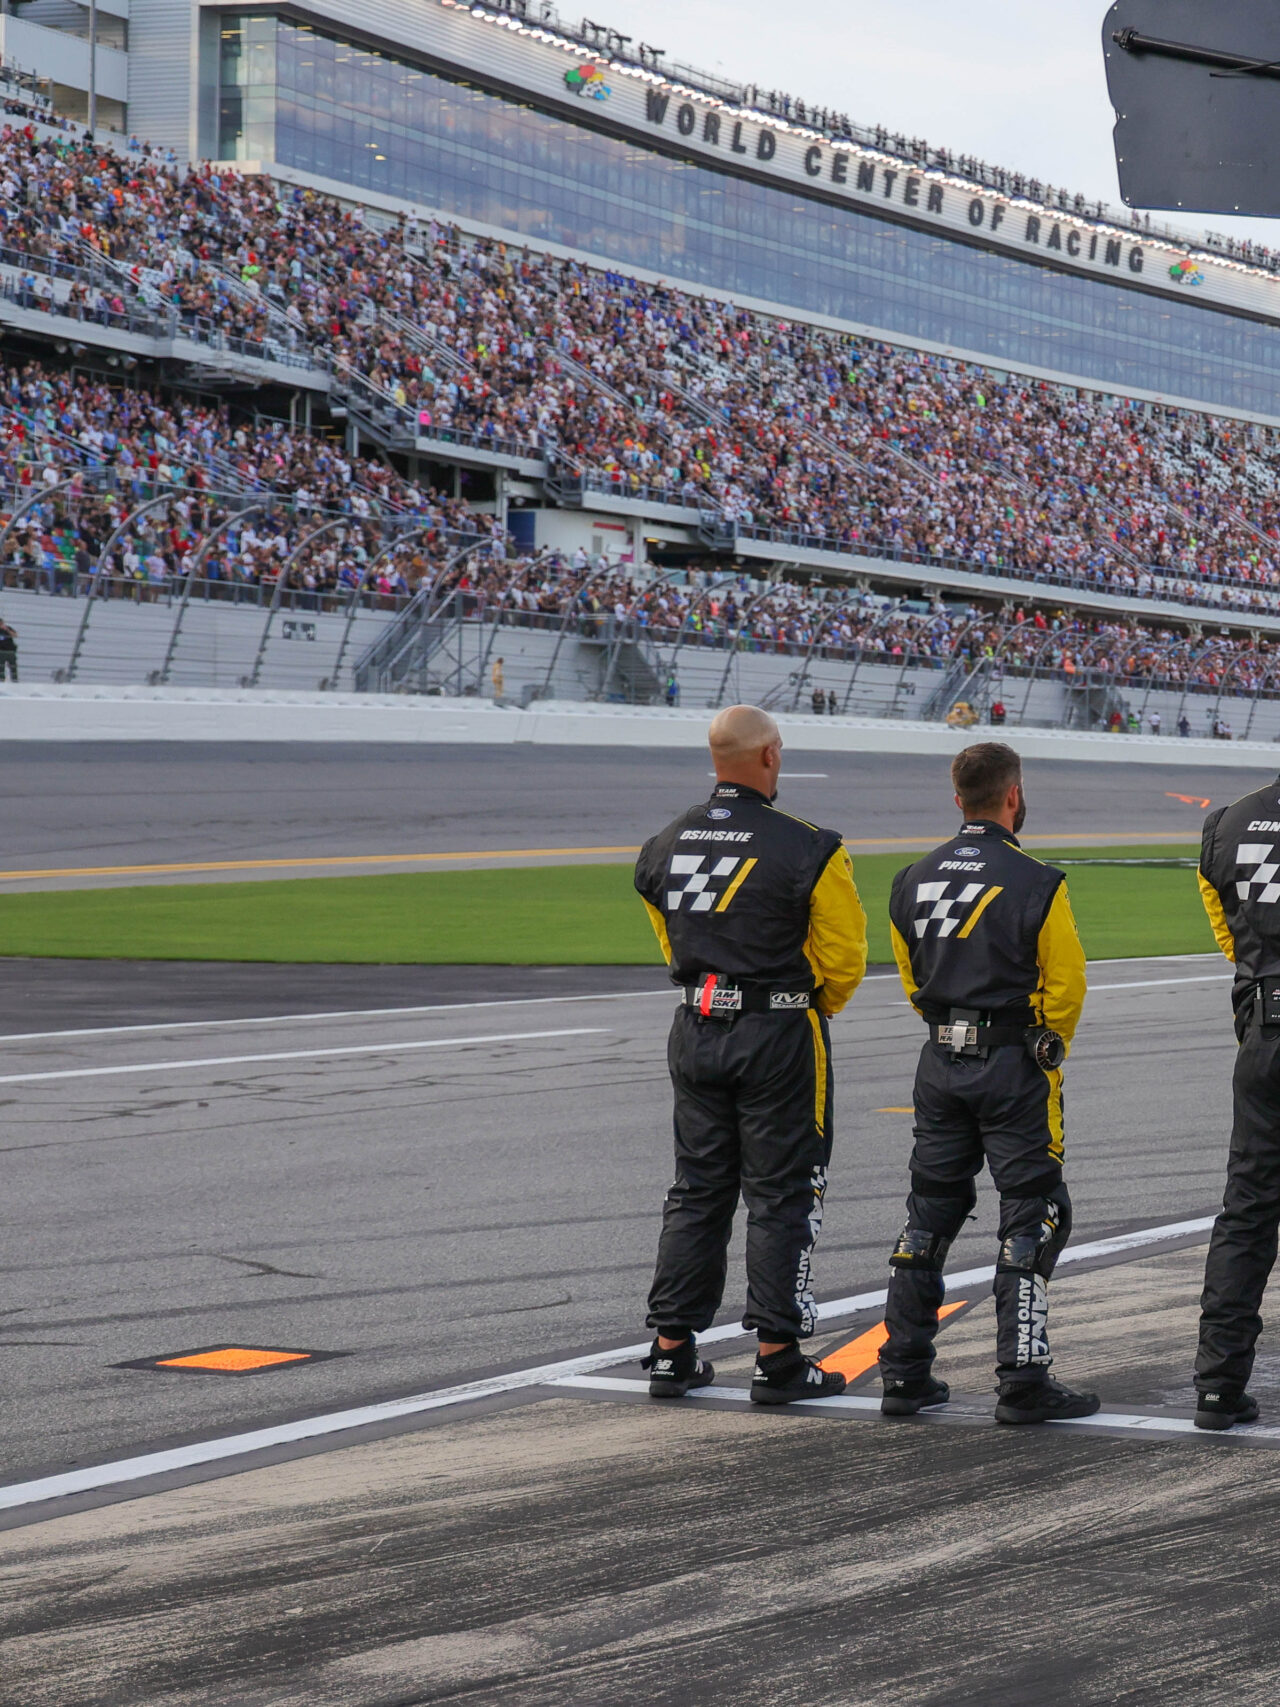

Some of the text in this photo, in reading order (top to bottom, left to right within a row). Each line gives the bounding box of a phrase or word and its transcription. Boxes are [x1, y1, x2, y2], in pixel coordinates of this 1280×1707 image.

[646, 88, 1144, 273] WORLD CENTER OF RACING
[679, 830, 754, 842] OSINSKIE
[937, 860, 986, 872] PRICE
[795, 1248, 810, 1291] AUTO
[1017, 1277, 1031, 1322] AUTO
[806, 1367, 823, 1385] N
